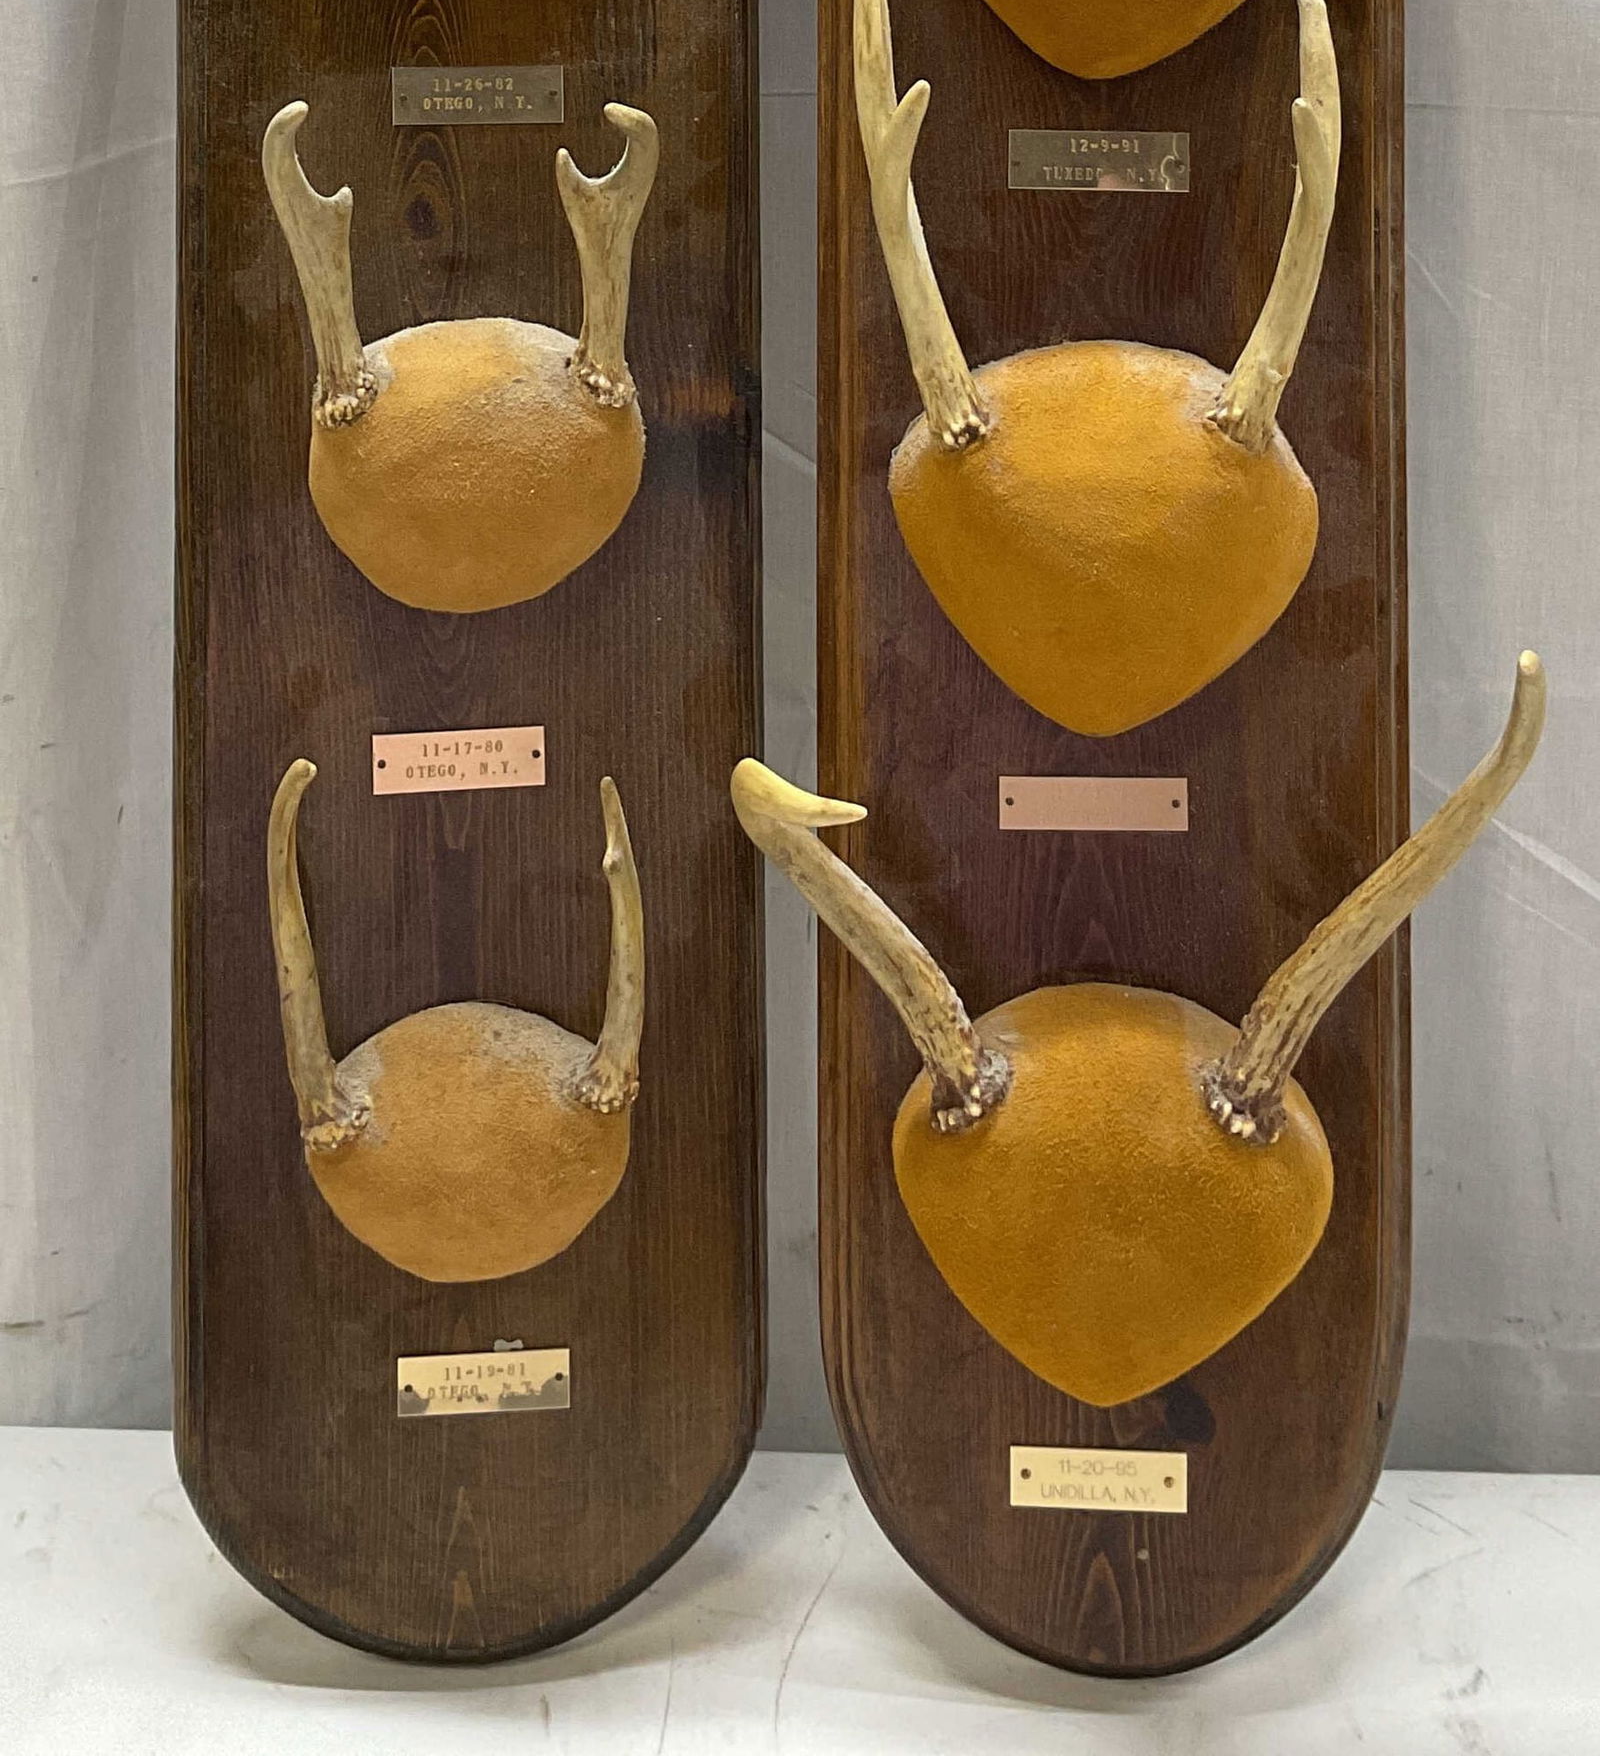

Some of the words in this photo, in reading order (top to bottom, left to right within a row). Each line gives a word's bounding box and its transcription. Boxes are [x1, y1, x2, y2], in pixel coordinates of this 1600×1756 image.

[433, 78, 514, 92] 11-26-82
[423, 97, 483, 113] OTEGO,
[494, 96, 533, 110] NY.
[1070, 138, 1140, 154] 12-9-91
[422, 740, 504, 757] 11-17-80
[405, 764, 466, 781] OTEGO,
[479, 761, 518, 776] N.Y.
